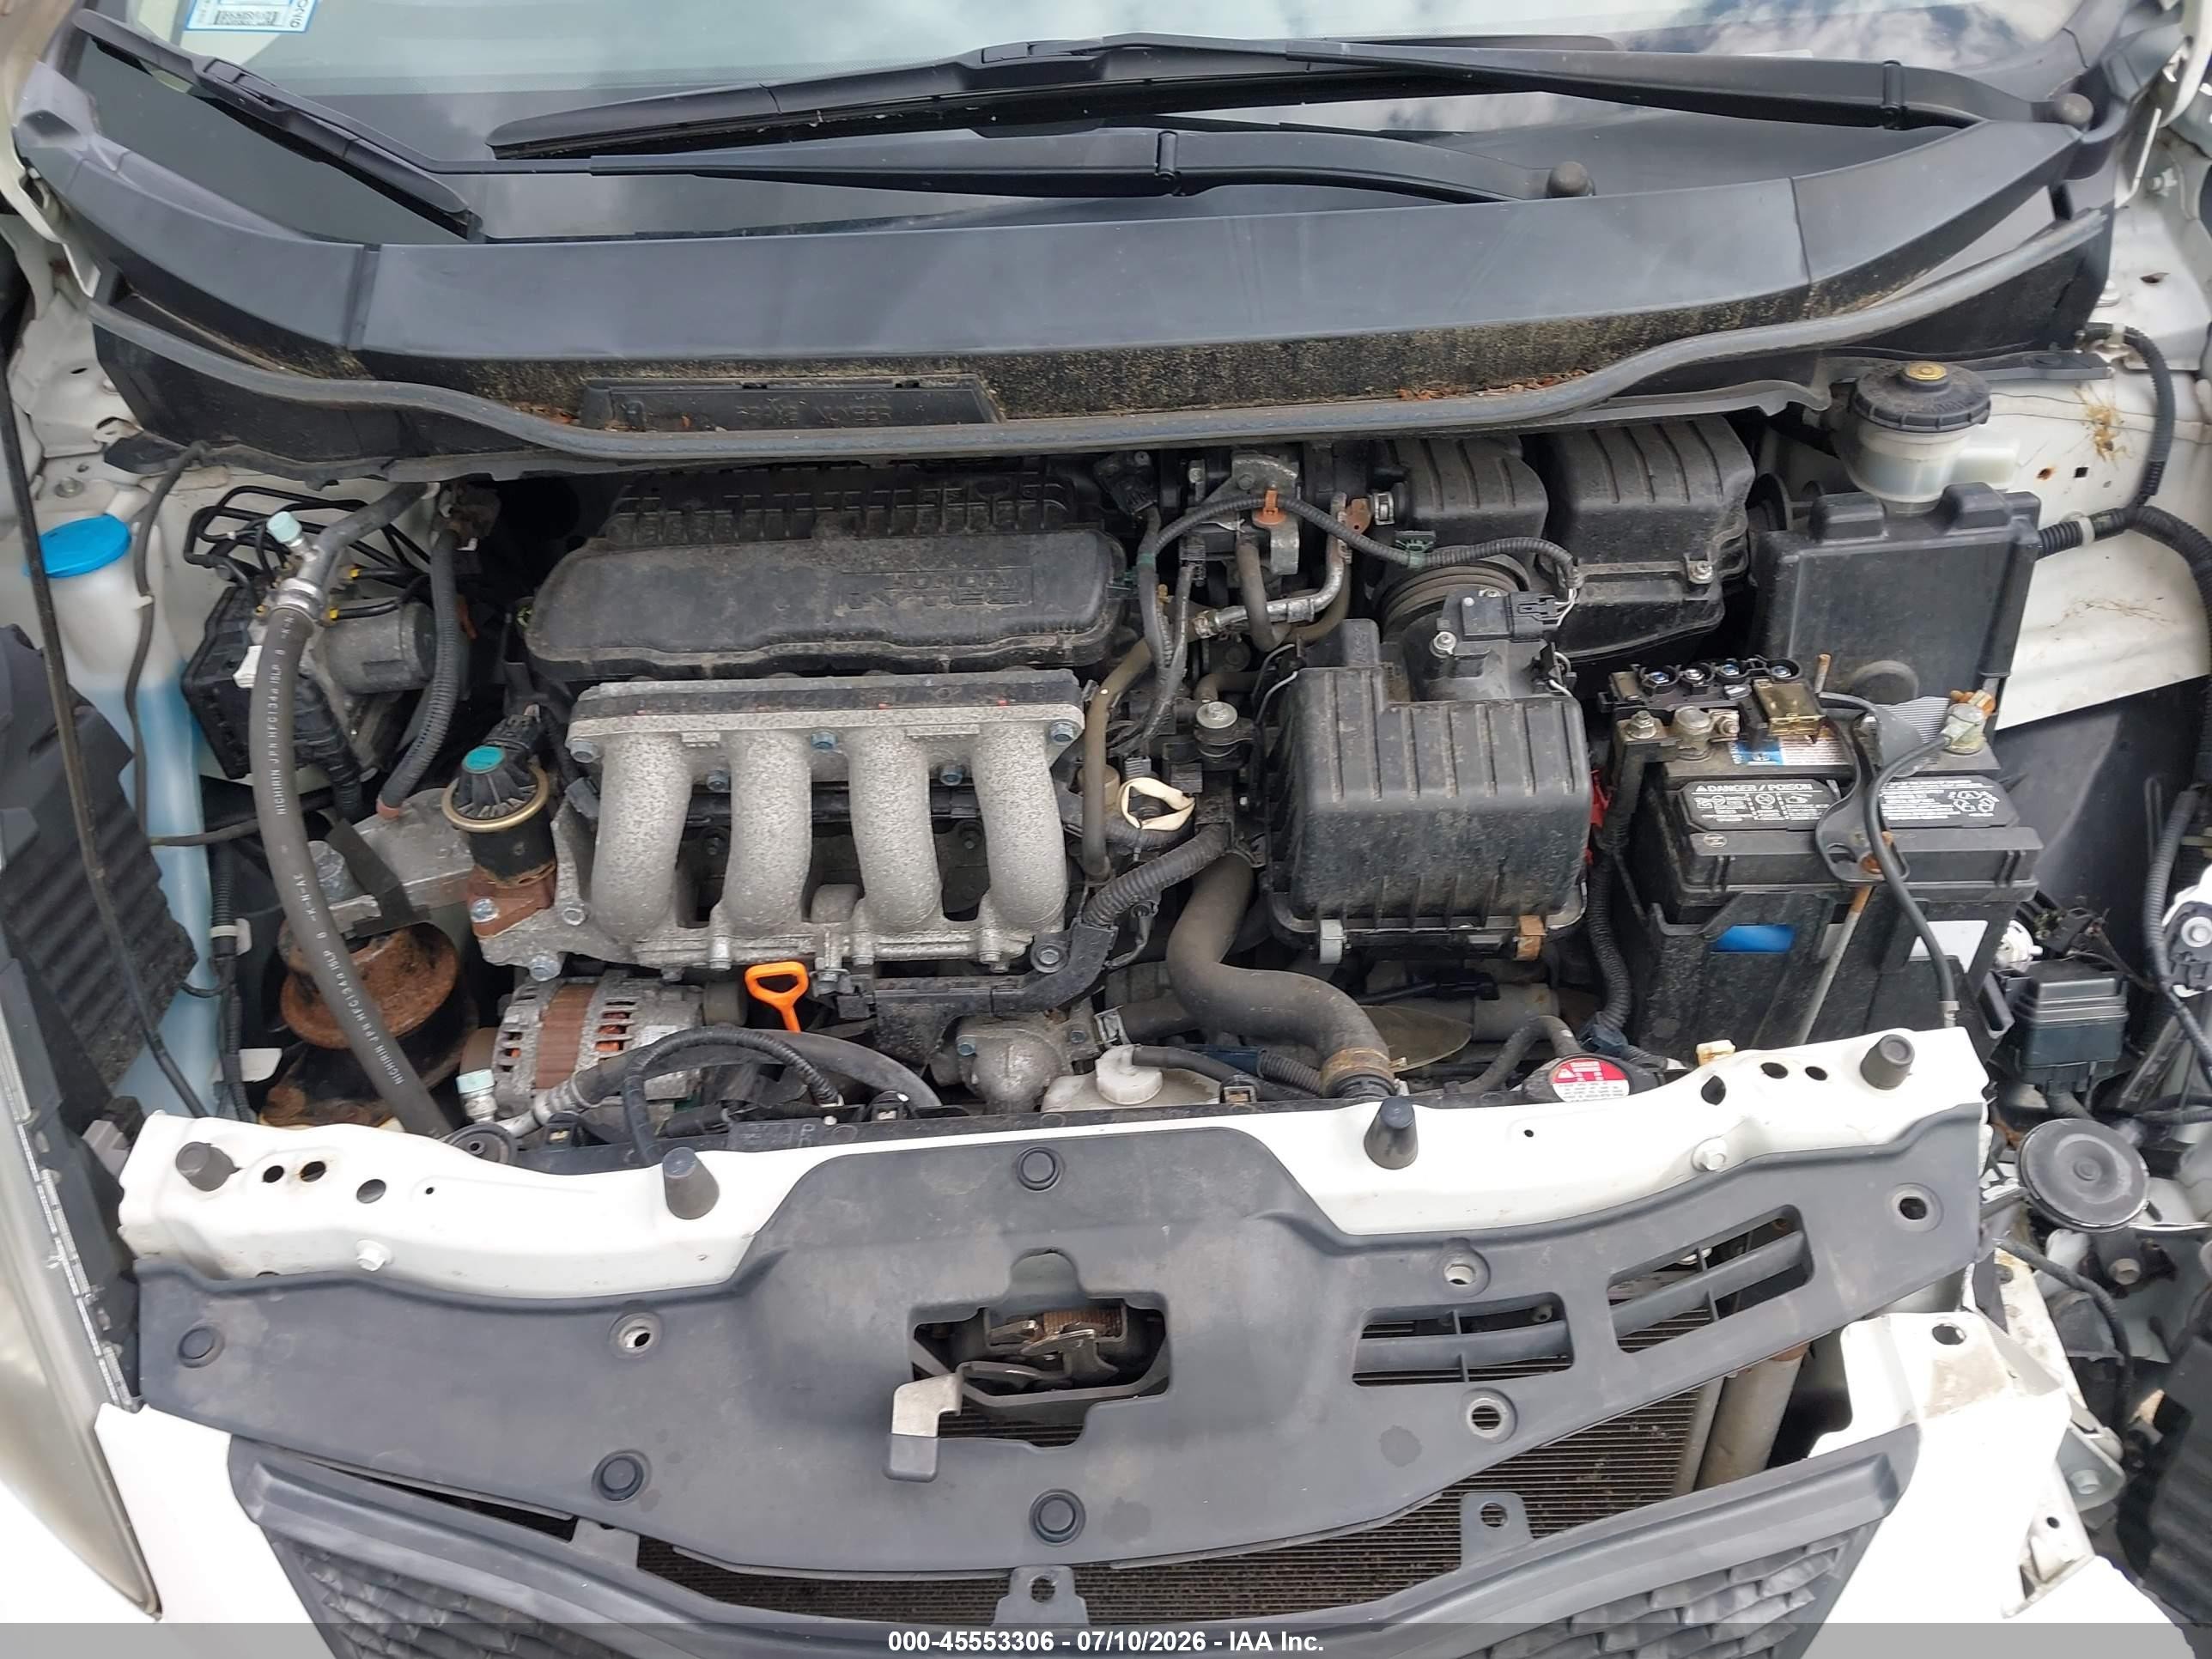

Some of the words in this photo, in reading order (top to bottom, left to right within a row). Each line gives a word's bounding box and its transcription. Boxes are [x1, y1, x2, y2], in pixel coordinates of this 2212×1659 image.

[267, 742, 280, 764] JPN
[270, 769, 287, 816] NICHIRIN
[1767, 782, 1814, 792] POISON
